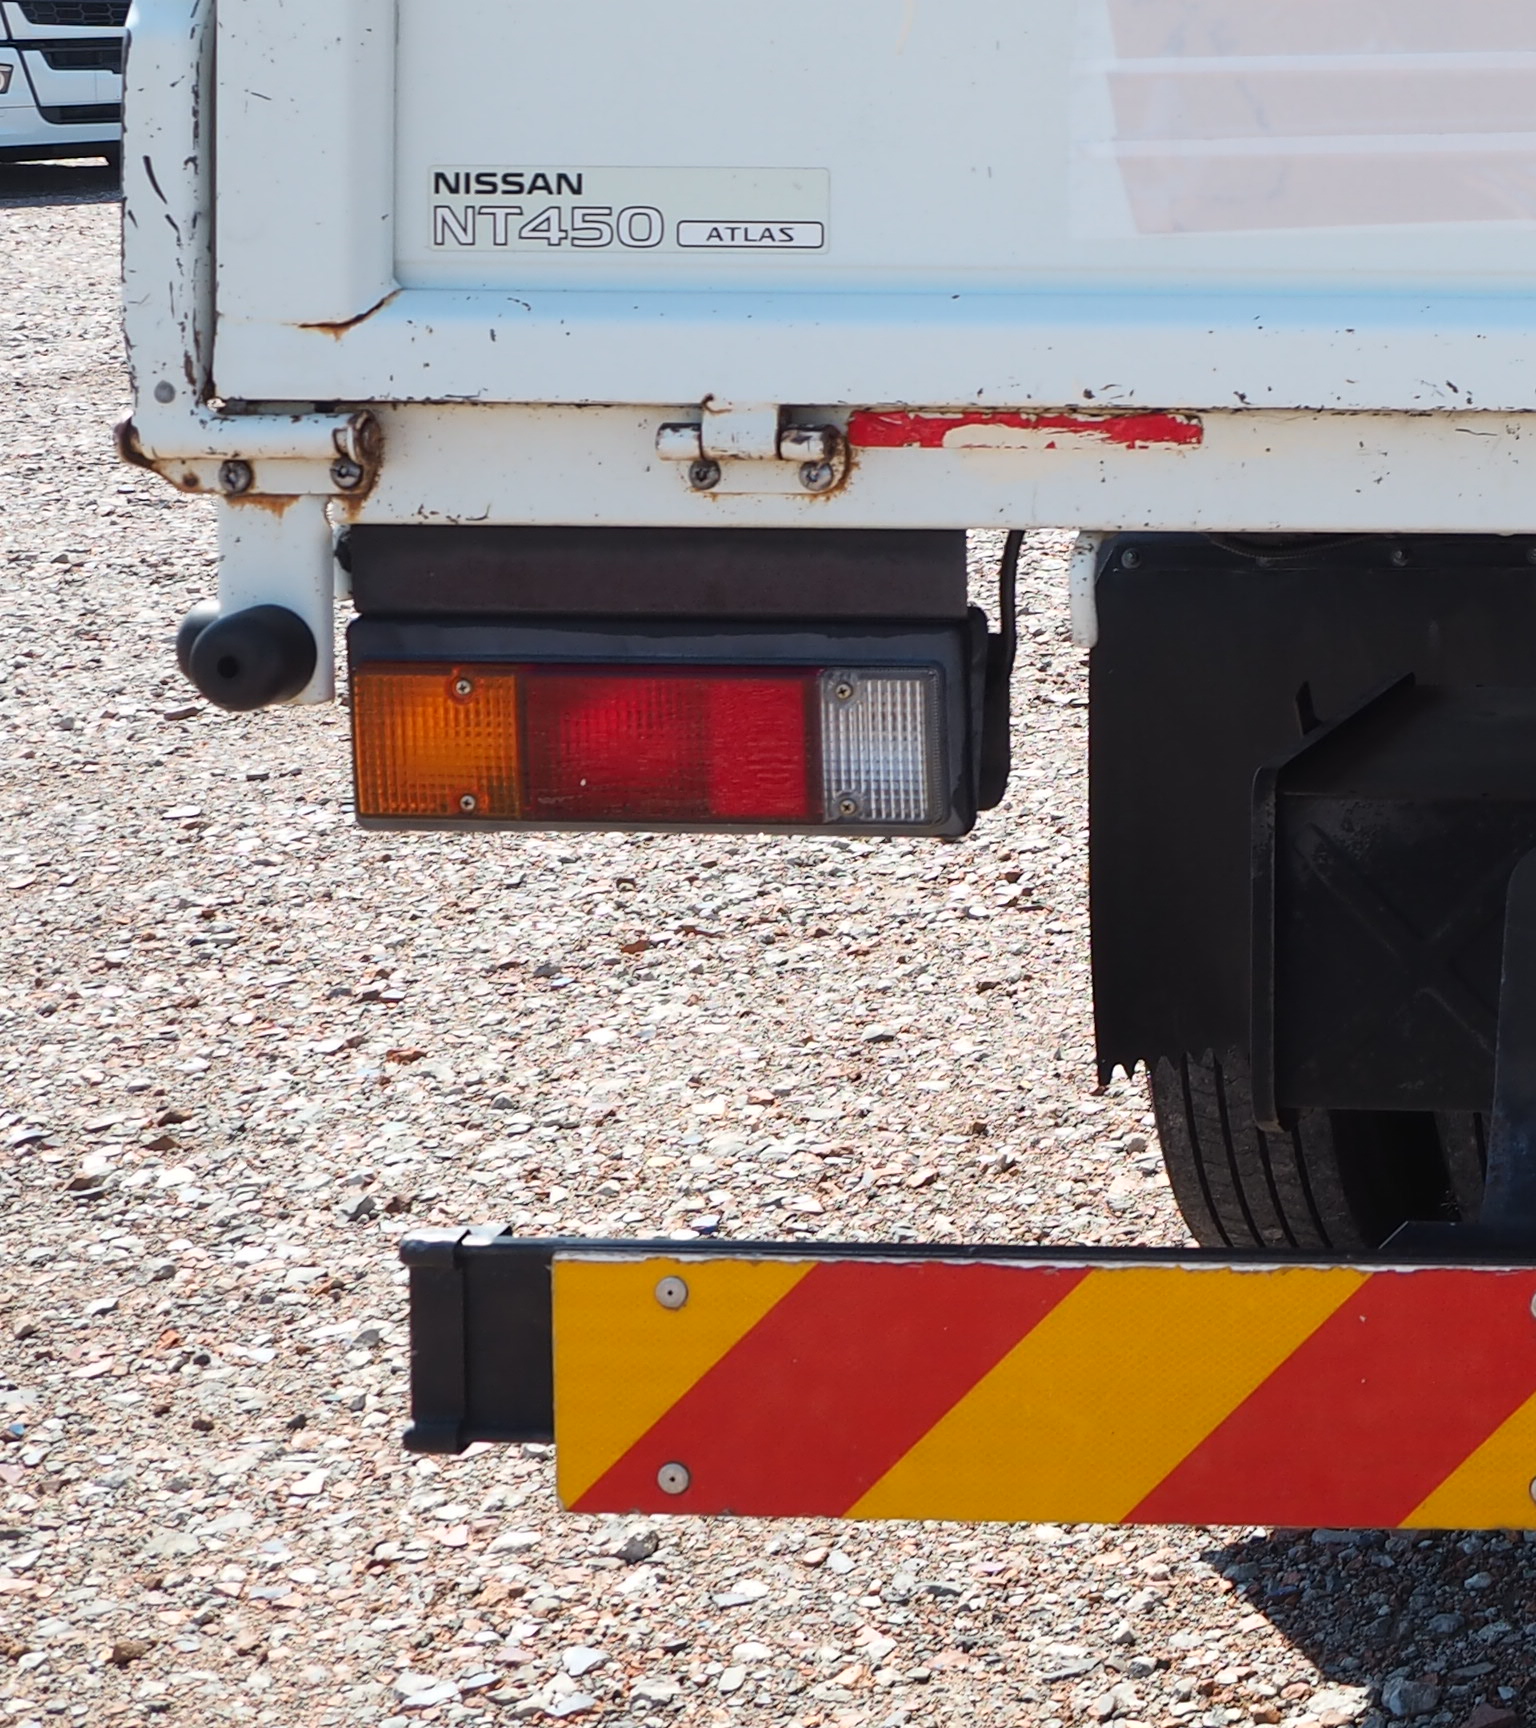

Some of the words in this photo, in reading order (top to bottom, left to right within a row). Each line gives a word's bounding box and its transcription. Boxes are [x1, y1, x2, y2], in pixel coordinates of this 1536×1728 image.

[433, 172, 583, 196] NISSAN
[432, 204, 665, 248] NT450
[705, 226, 796, 243] ATLAS
